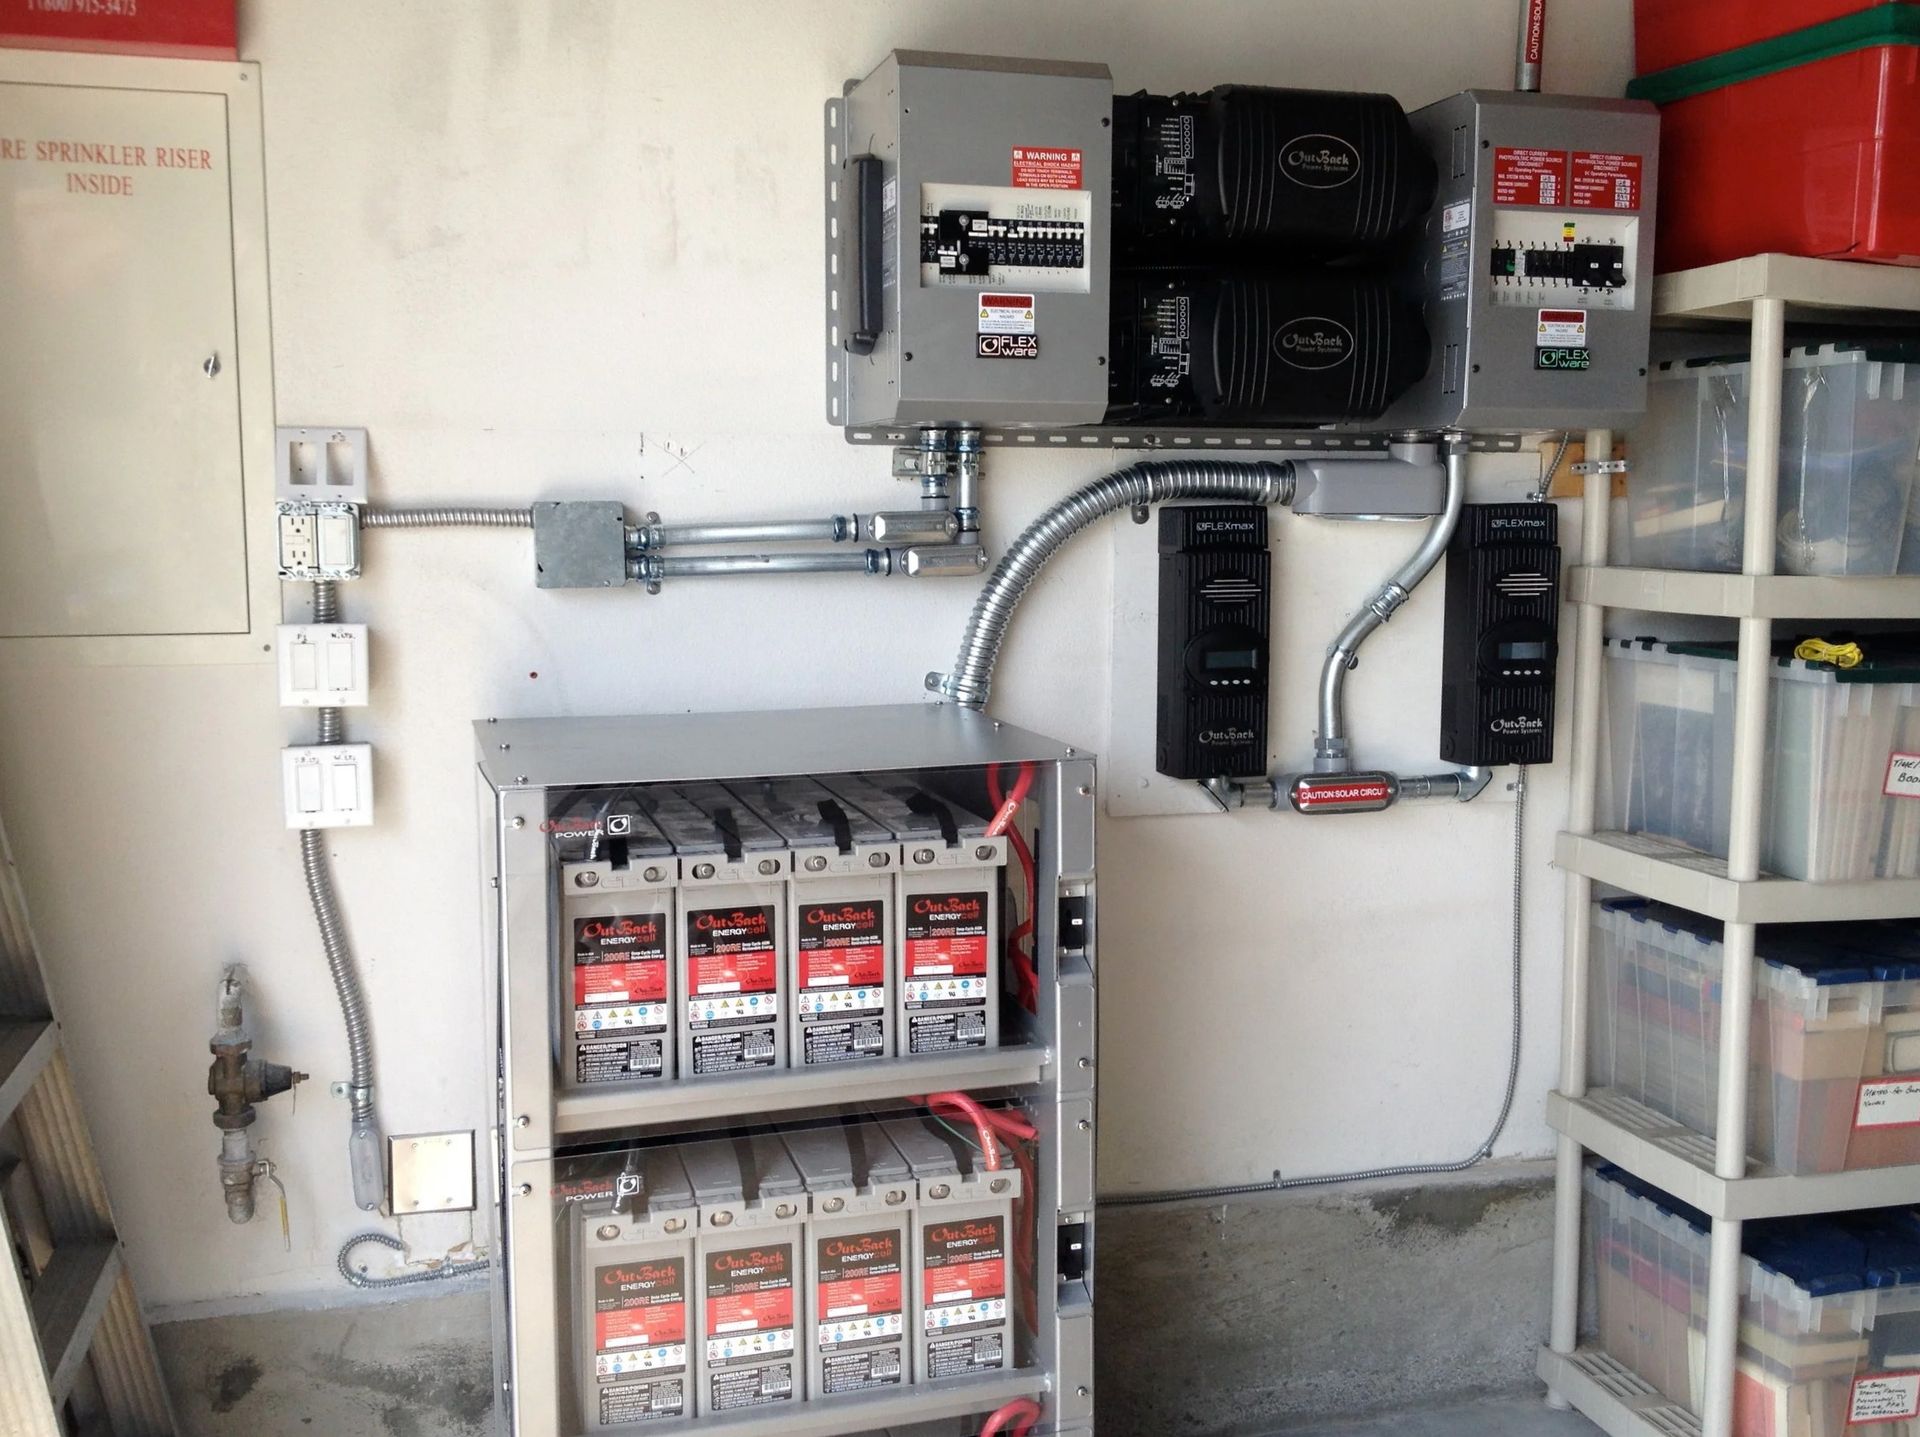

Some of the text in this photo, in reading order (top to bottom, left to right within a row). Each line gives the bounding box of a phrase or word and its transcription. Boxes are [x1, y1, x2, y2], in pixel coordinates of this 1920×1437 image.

[36, 140, 148, 167] SPRINKLER
[156, 147, 212, 170] RISER
[1026, 151, 1068, 161] WARNING
[1288, 150, 1349, 166] OutBack
[66, 172, 134, 196] INSIDE
[1001, 336, 1037, 348] FLEX
[1282, 332, 1342, 348] OutBack
[1001, 348, 1038, 357] ware
[1558, 349, 1589, 360] FLEX
[1558, 360, 1590, 368] ware
[1205, 522, 1255, 531] FLEXmax
[1500, 519, 1546, 527] FLEXmax
[1491, 716, 1543, 732] OutBack
[1199, 727, 1254, 743] OutBack
[1898, 772, 1920, 783] BOO
[1360, 788, 1385, 796] CIRCU
[555, 829, 604, 839] POWER
[914, 898, 980, 913] OutBack
[696, 912, 766, 929] OutBack
[807, 907, 875, 924] OutBack
[583, 920, 657, 937] OutBack
[932, 927, 956, 936] 200RE
[716, 943, 741, 953] 200RE
[826, 937, 850, 947] 200RE
[604, 952, 630, 962] 200RE
[565, 1191, 614, 1202] POWER
[931, 1224, 996, 1242] OutBack
[826, 1238, 893, 1256] OutBack
[715, 1252, 784, 1270] OutBack
[604, 1265, 675, 1284] OutBack
